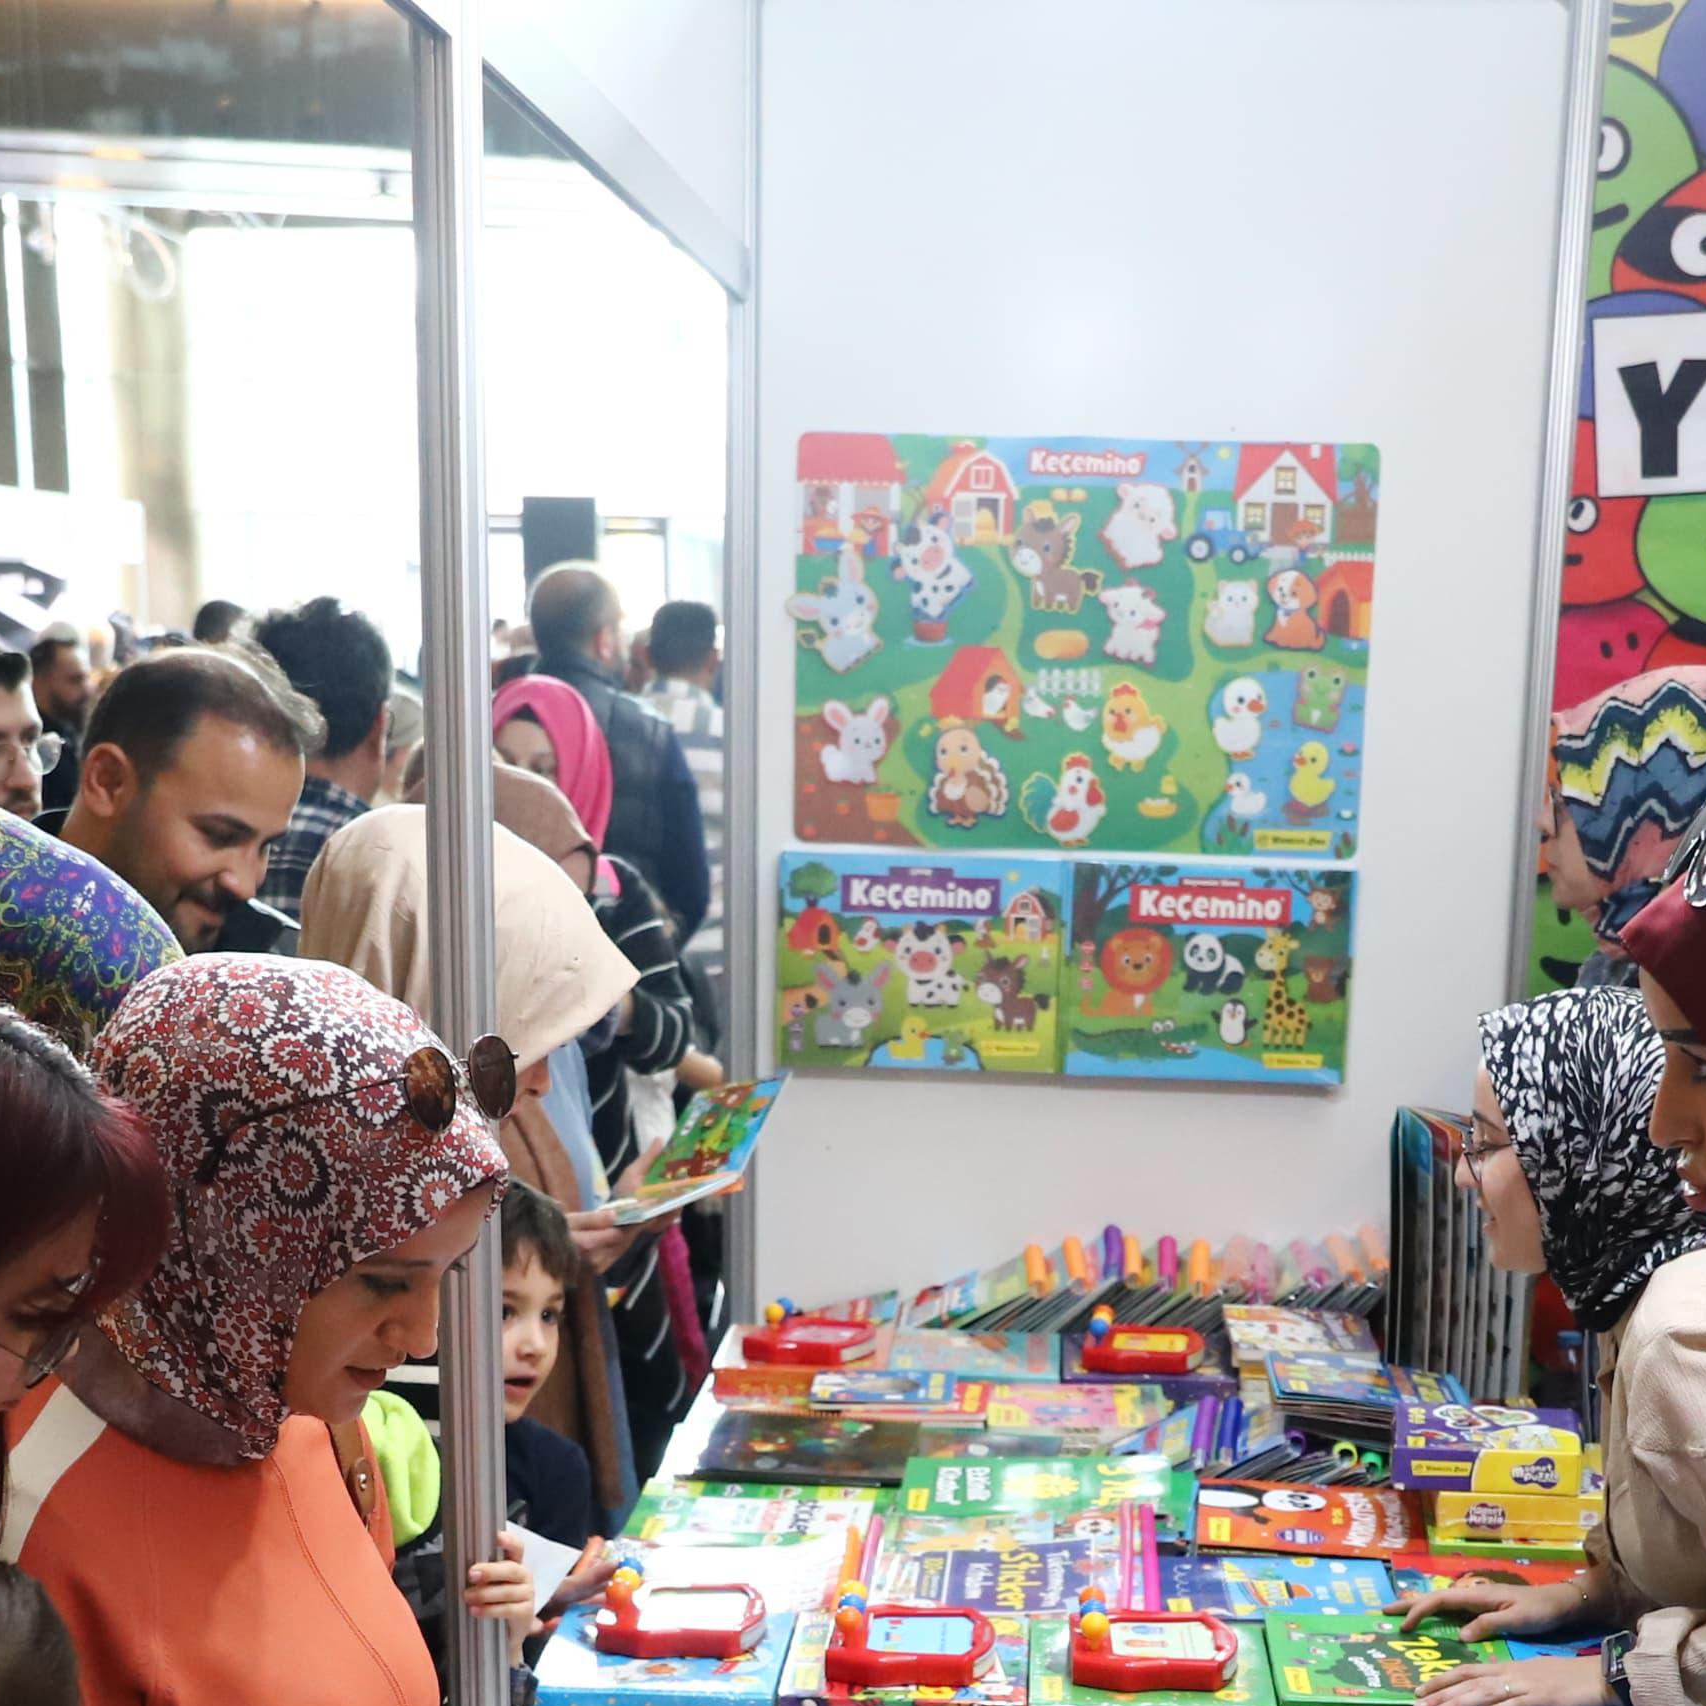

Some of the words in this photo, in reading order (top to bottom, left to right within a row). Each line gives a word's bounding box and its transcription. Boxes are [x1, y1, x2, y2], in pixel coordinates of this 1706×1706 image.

[1029, 449, 1145, 477] Keçemino
[849, 876, 994, 912] Keçemino
[1138, 887, 1283, 923] Keçemino
[994, 1551, 1039, 1610] Sticker
